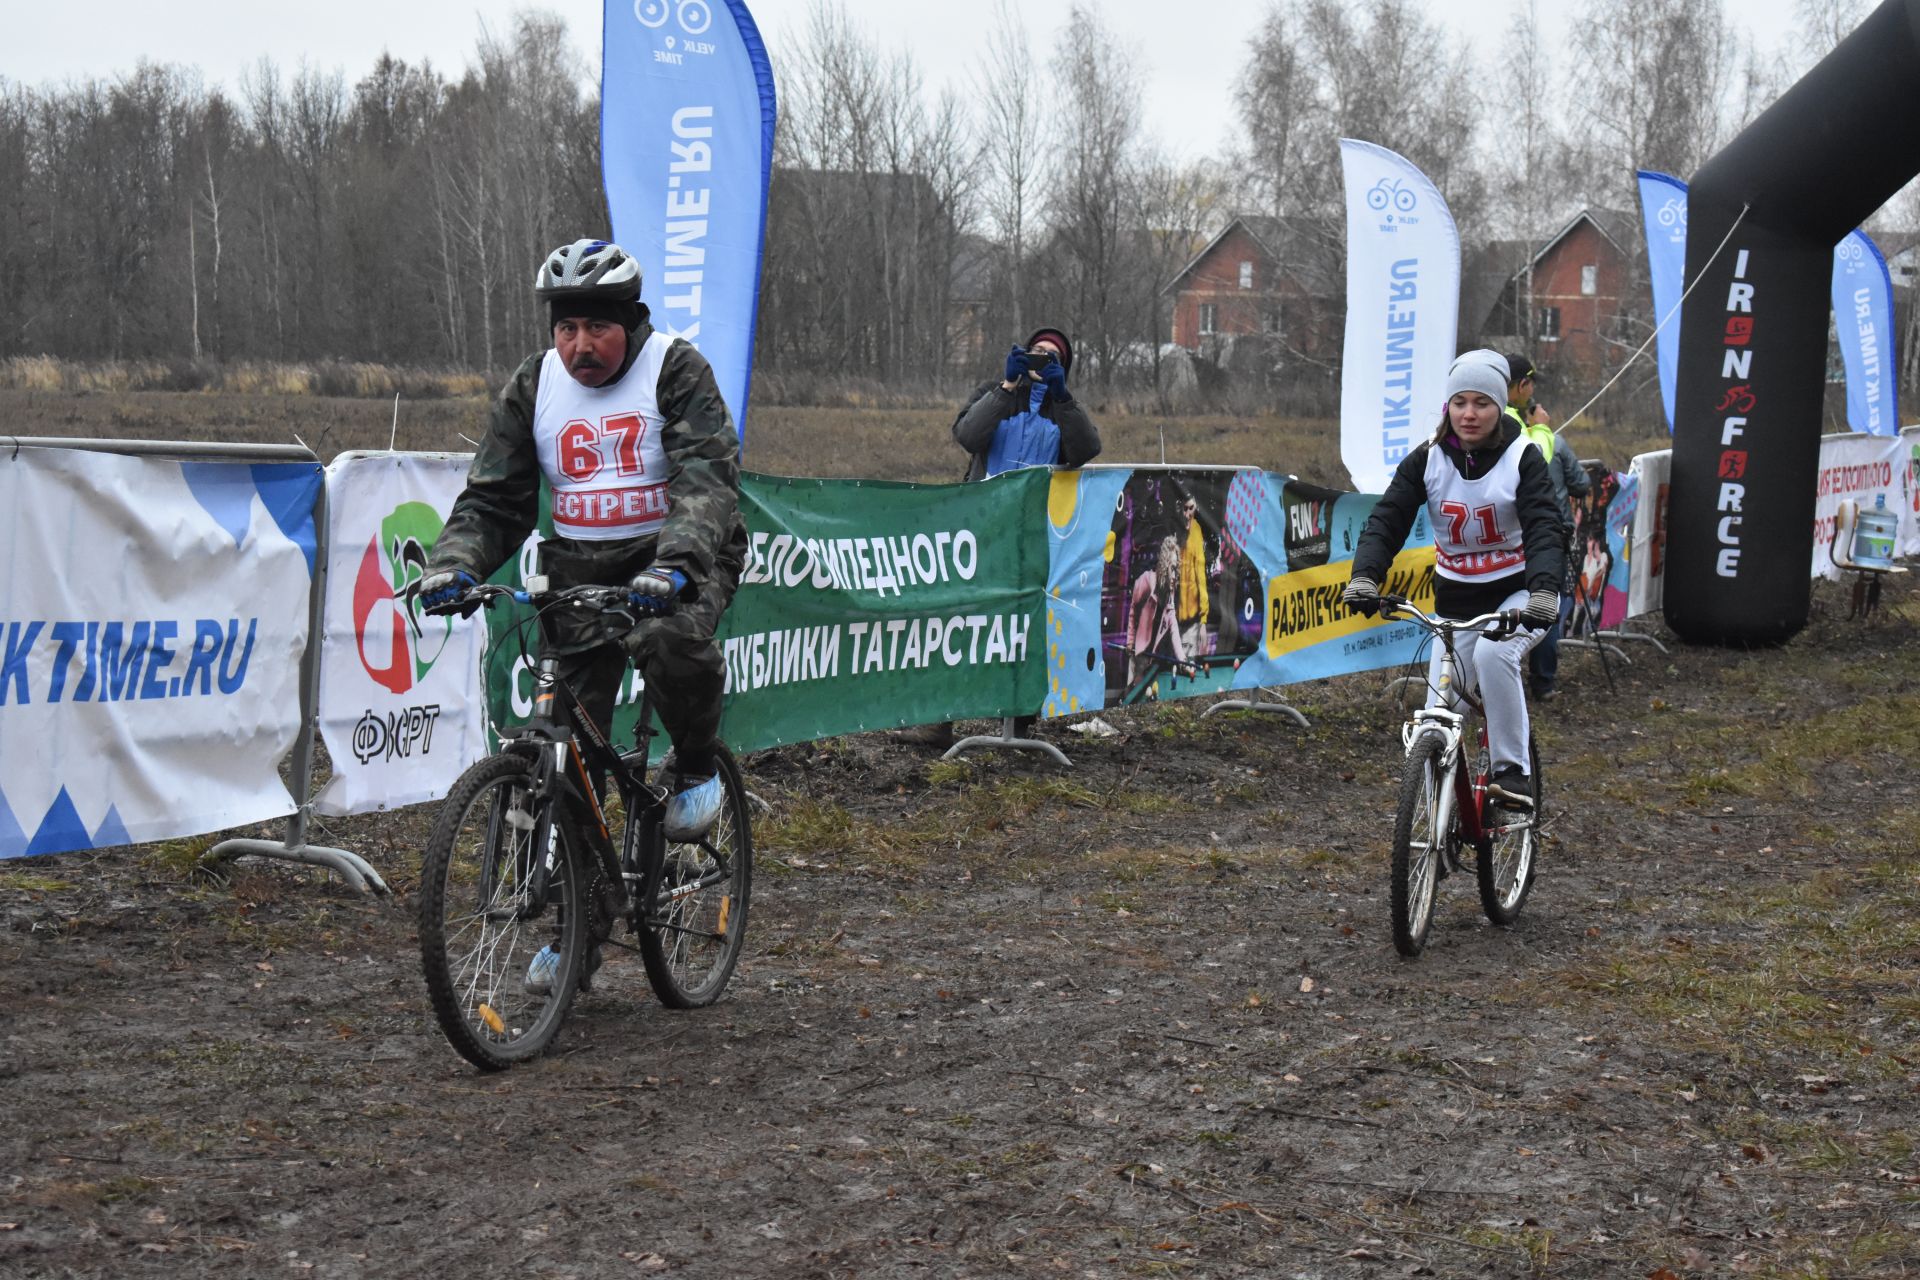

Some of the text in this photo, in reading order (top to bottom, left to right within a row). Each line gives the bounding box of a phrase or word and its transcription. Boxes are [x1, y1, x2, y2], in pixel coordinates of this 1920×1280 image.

[556, 411, 647, 484] 67
[552, 487, 669, 521] ЕСТРЕЦ
[1290, 500, 1328, 542] FUN24
[1440, 500, 1507, 546] 71
[848, 613, 1030, 675] ТАТАРСТАН
